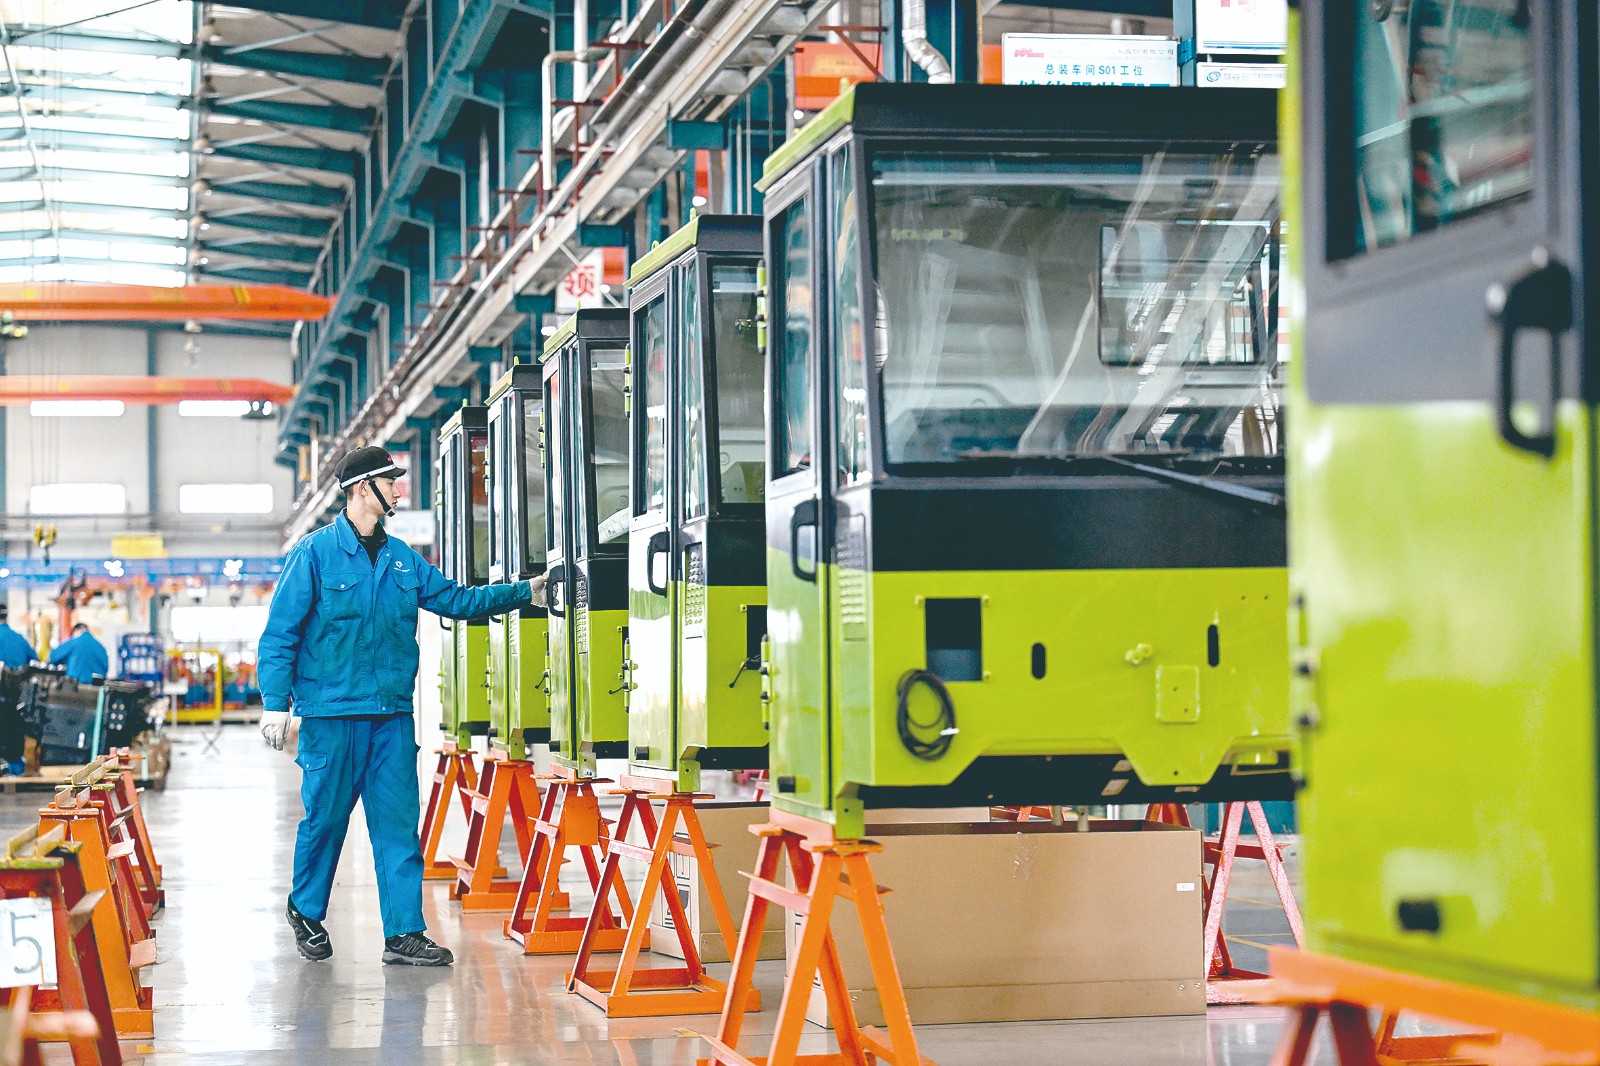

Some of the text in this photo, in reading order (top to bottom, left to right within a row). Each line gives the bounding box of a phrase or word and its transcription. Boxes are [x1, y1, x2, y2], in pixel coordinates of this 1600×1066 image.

[1045, 63, 1144, 76] 总装车间S01工位
[10, 911, 43, 975] 5
